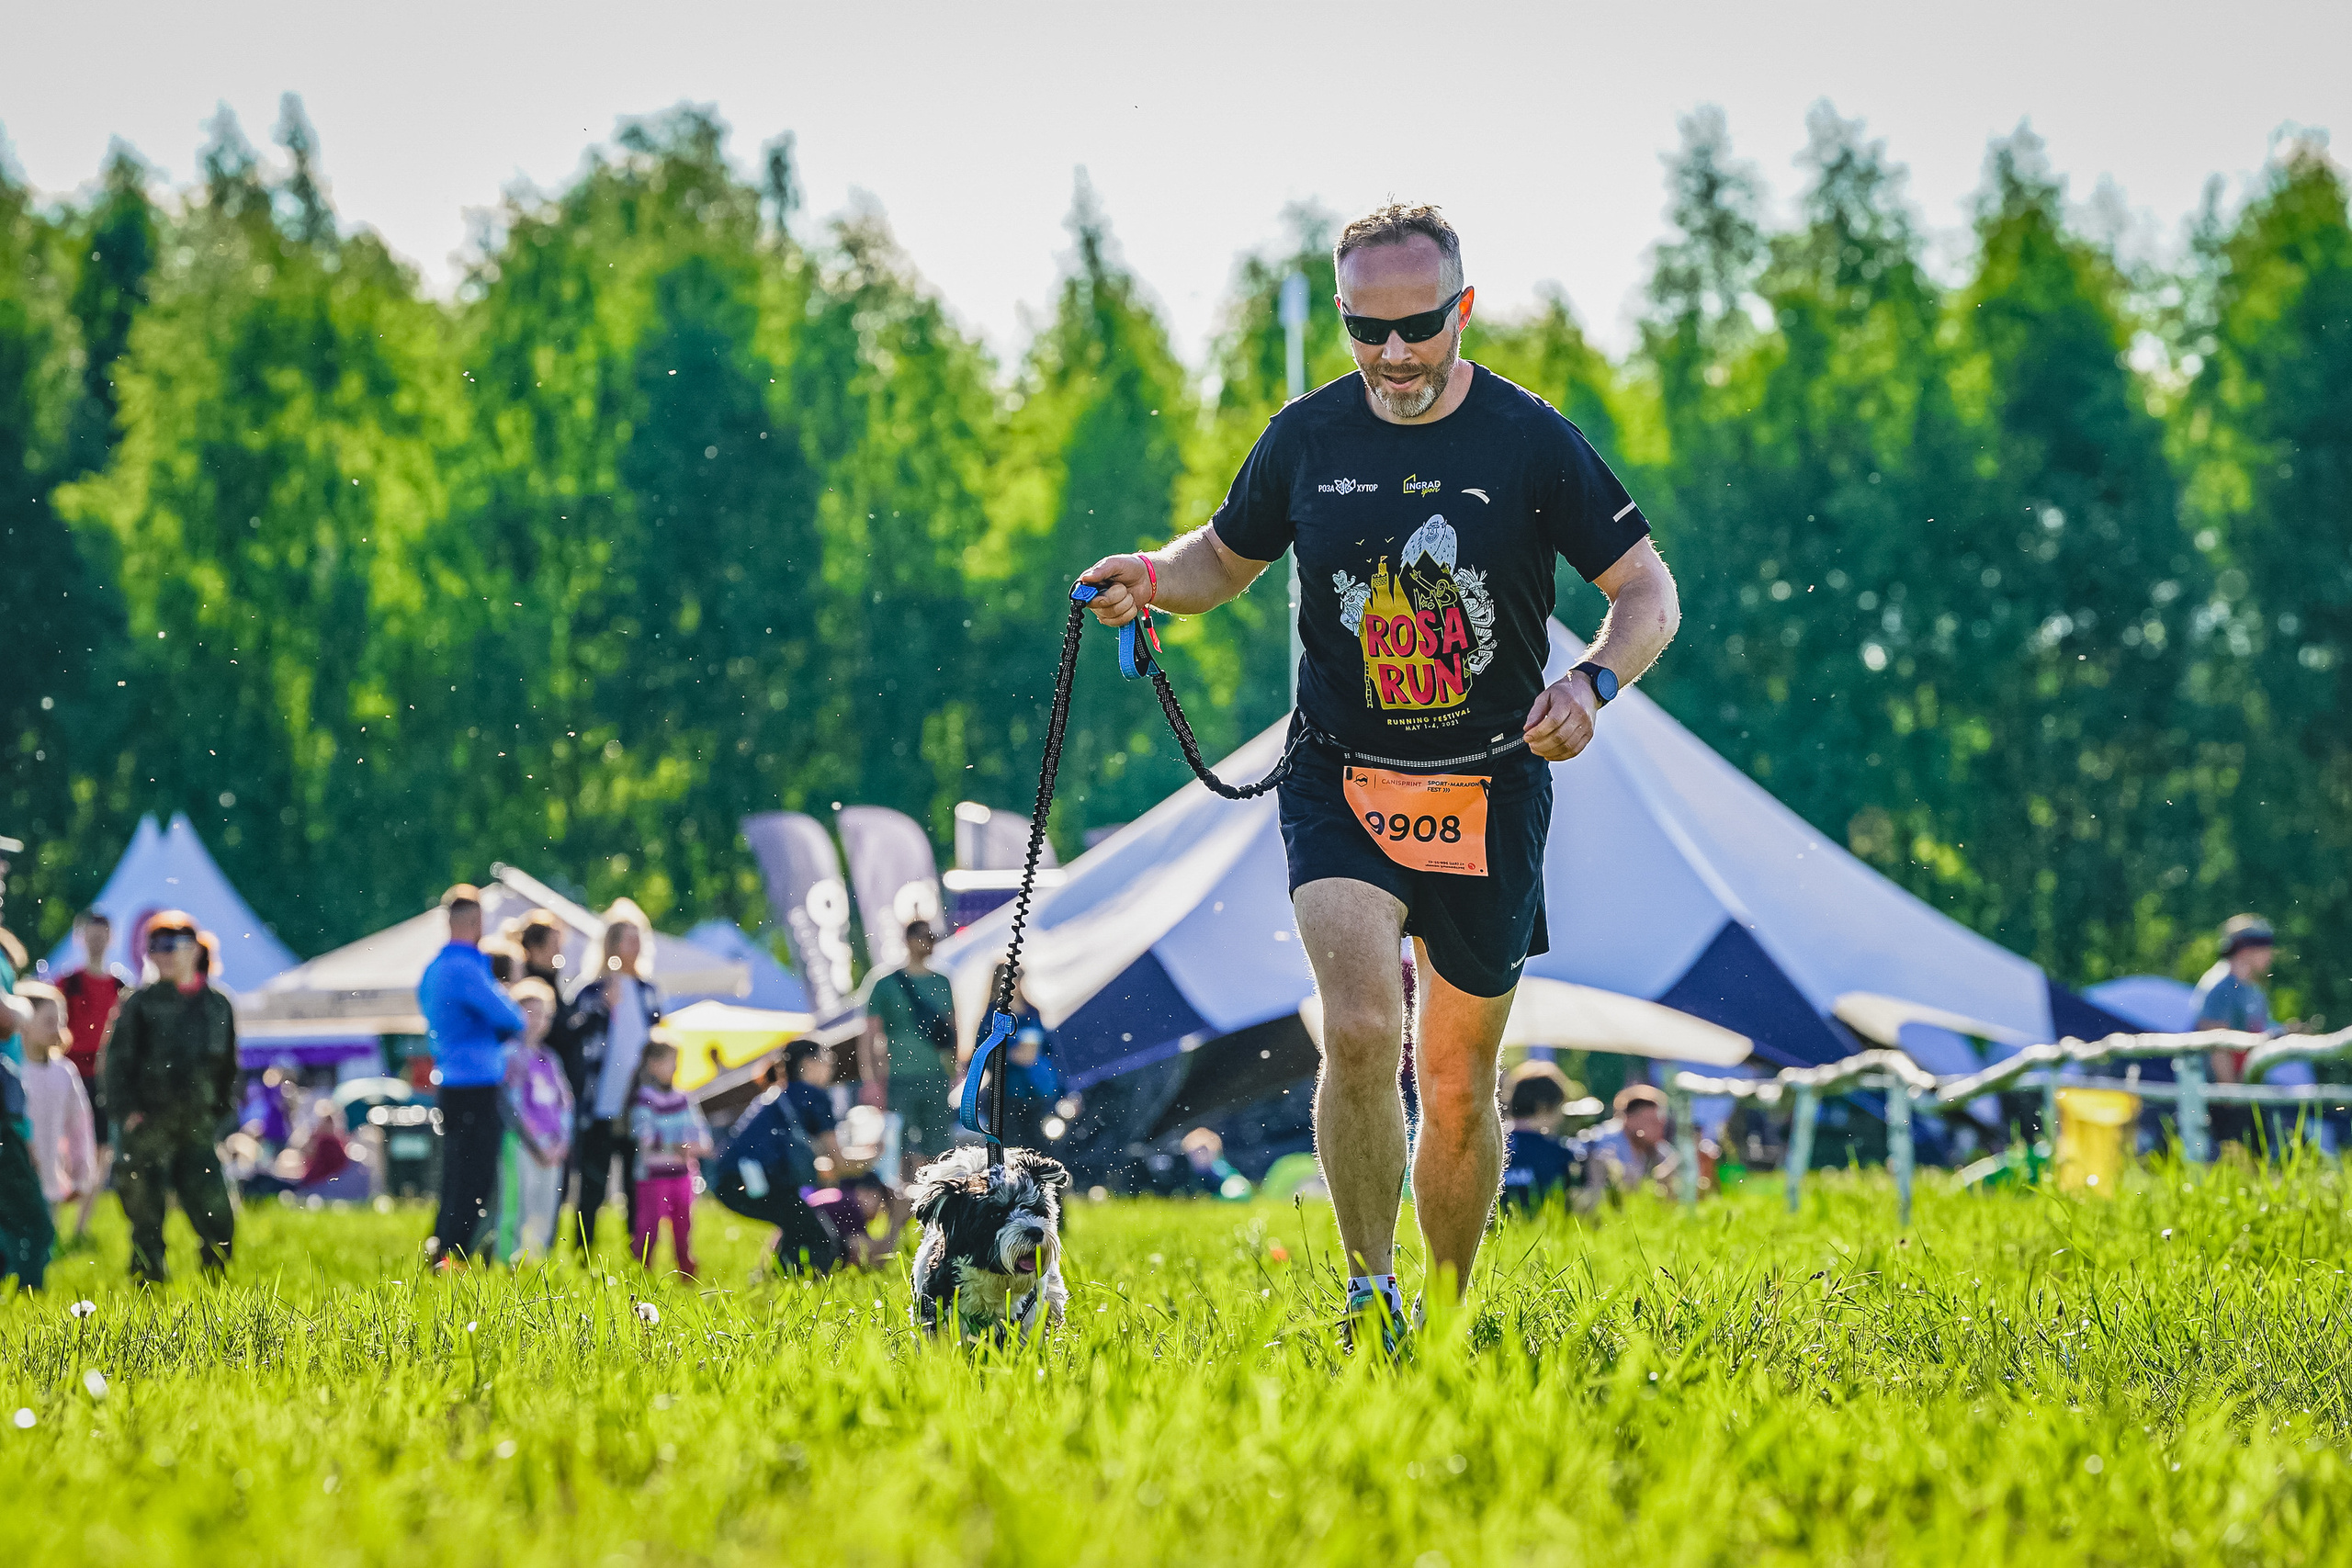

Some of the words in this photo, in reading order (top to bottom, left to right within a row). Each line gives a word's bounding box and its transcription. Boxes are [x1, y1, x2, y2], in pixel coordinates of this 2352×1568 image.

[1317, 484, 1335, 492] РОЗА
[1356, 484, 1378, 492] ХУТОР
[1406, 480, 1441, 490] INGRAD
[1365, 607, 1468, 658] ROSA
[1378, 653, 1465, 705] RUN
[1386, 716, 1430, 726] RUNNING
[1433, 707, 1471, 722] FESTIVAL
[1442, 718, 1459, 728] 2021
[1381, 779, 1422, 787] CANISPRINT
[1364, 811, 1461, 843] 9908
